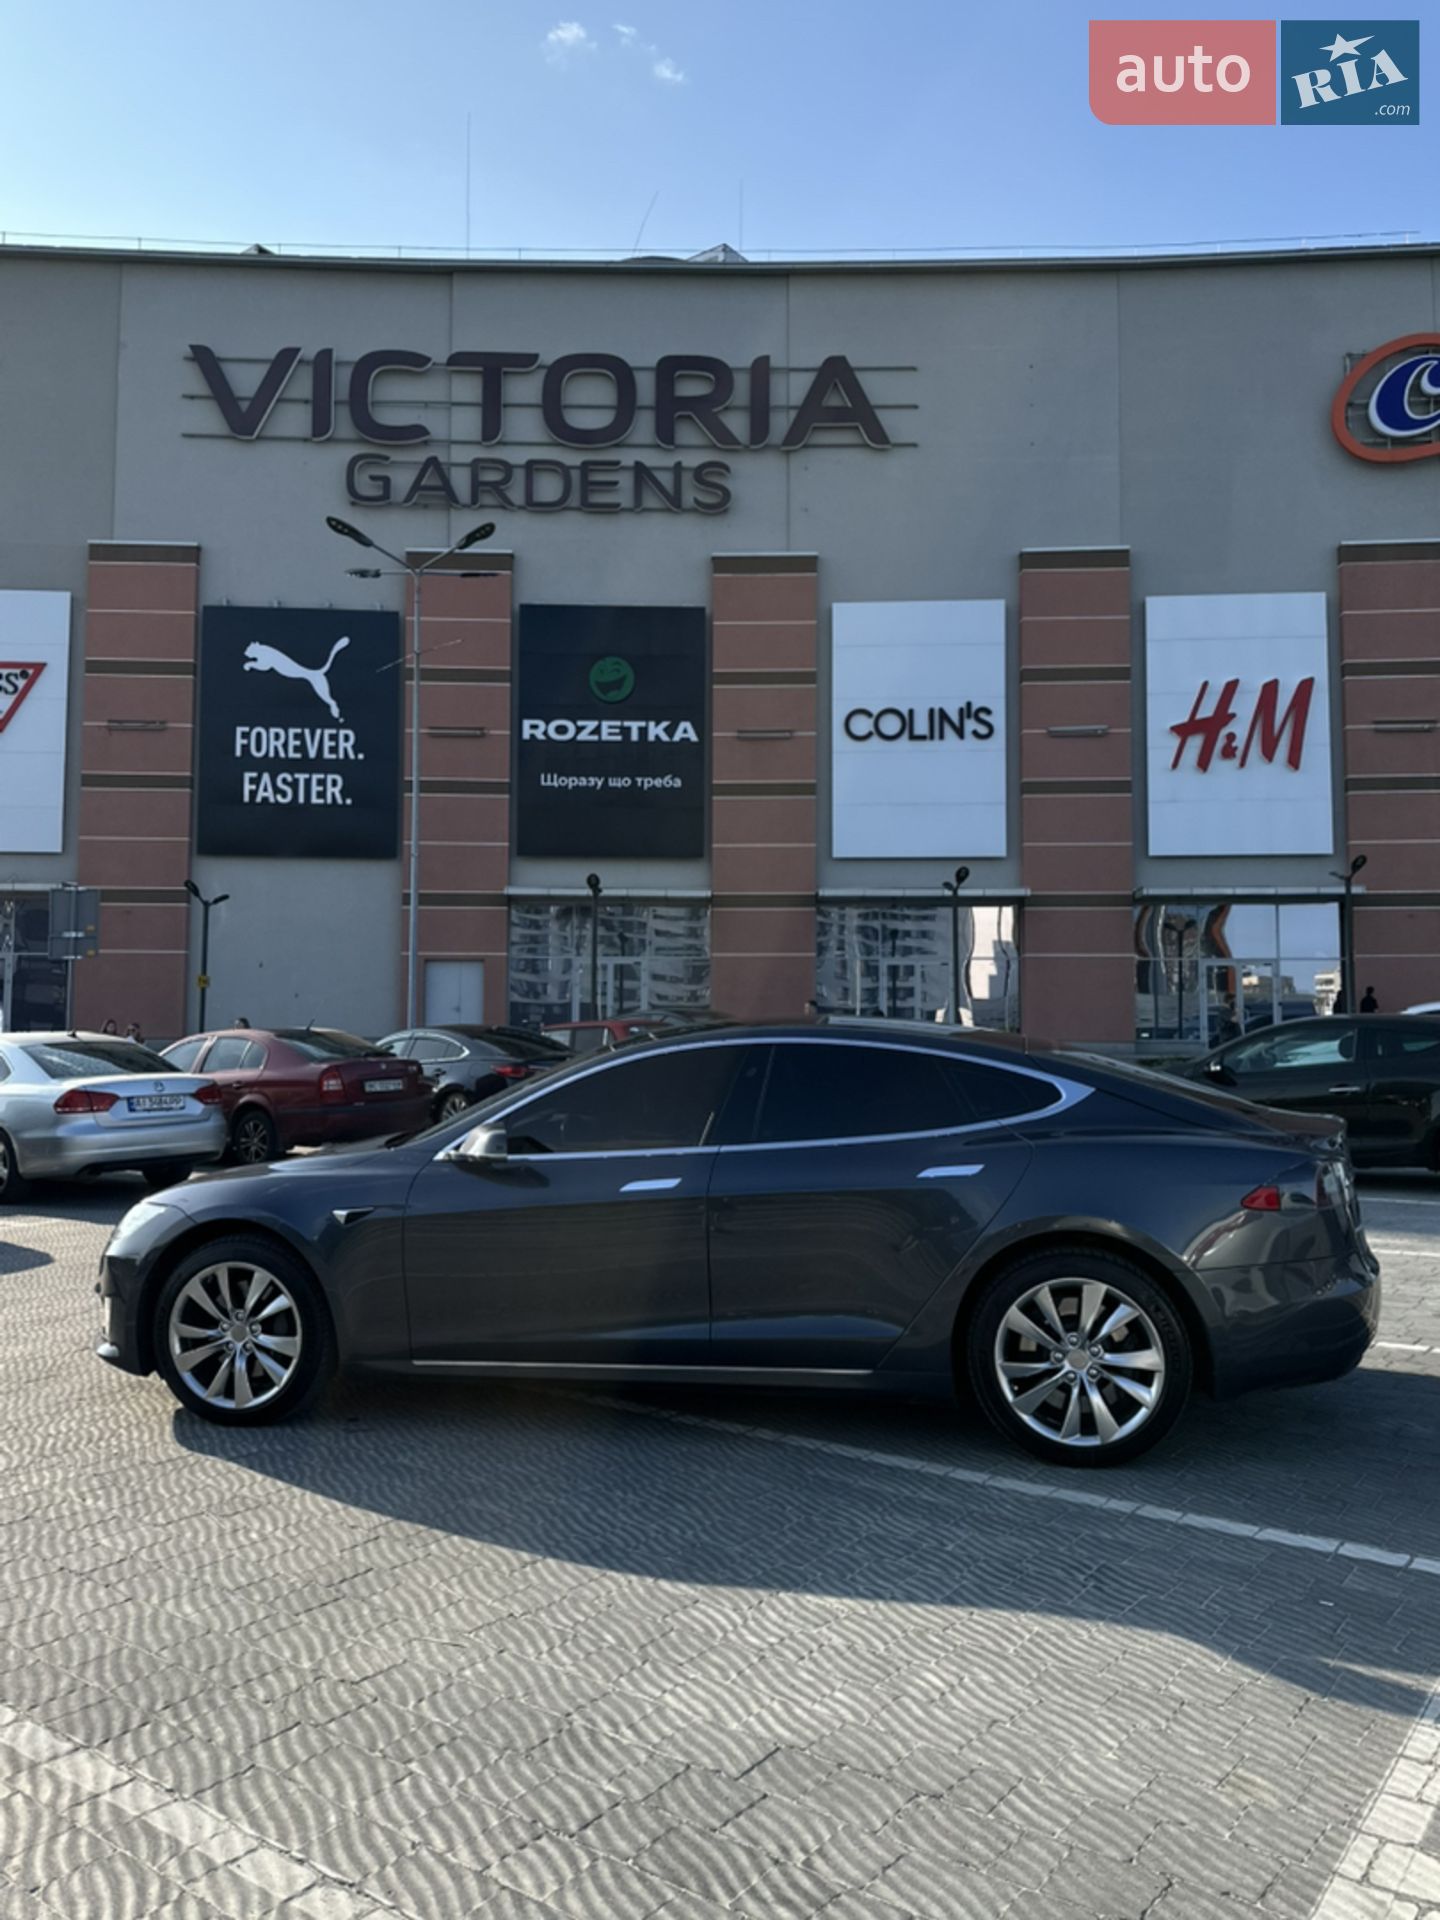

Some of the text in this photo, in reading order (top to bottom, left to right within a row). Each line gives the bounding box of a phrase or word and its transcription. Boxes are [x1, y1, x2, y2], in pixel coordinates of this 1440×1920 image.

[188, 344, 892, 450] VICTORIA
[344, 452, 732, 513] GARDENS
[521, 719, 699, 742] ROZETKA
[843, 701, 994, 741] COLIN'S
[1169, 677, 1315, 773] H&M
[234, 726, 365, 760] FOREVER.
[242, 772, 353, 805] FASTER.
[540, 773, 682, 791] Щоразу що треба
